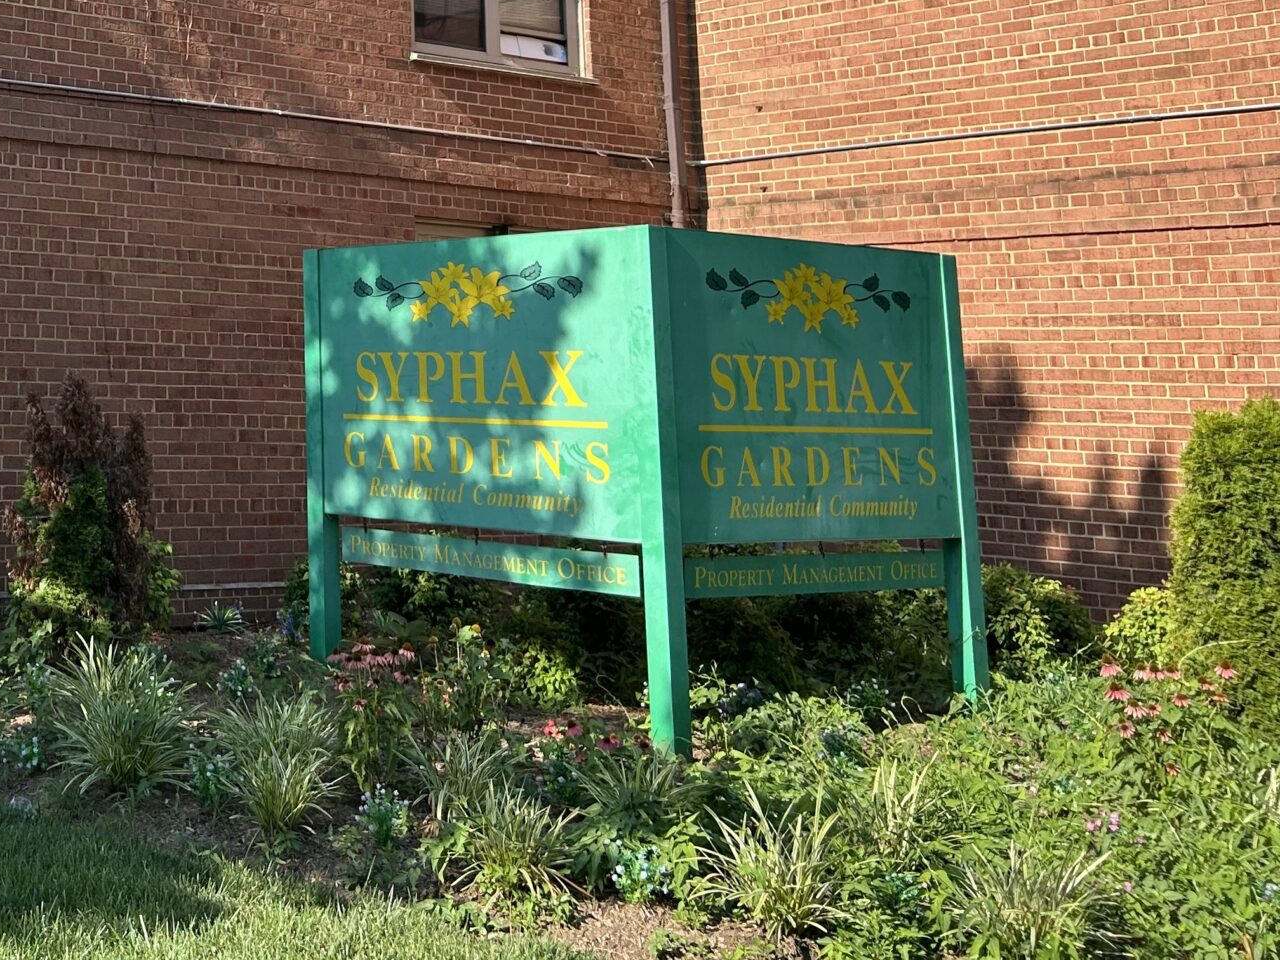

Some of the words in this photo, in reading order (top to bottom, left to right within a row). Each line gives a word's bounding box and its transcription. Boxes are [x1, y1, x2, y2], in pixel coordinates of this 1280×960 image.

[355, 350, 587, 409] SYPHAX
[710, 353, 918, 416] SYPHAX
[344, 431, 611, 485] GARDENS
[700, 446, 937, 488] GARDENS
[369, 476, 464, 505] Residential
[471, 483, 582, 517] Community
[729, 494, 821, 519] Residential
[830, 493, 918, 520] Community
[350, 534, 426, 562] PROPERTY
[434, 546, 549, 577] MANAGEMENT
[558, 556, 627, 586] OFFICE
[693, 565, 775, 589] PROPERTY
[783, 562, 883, 585] MANAGEMENT
[890, 559, 937, 579] OFFICE
